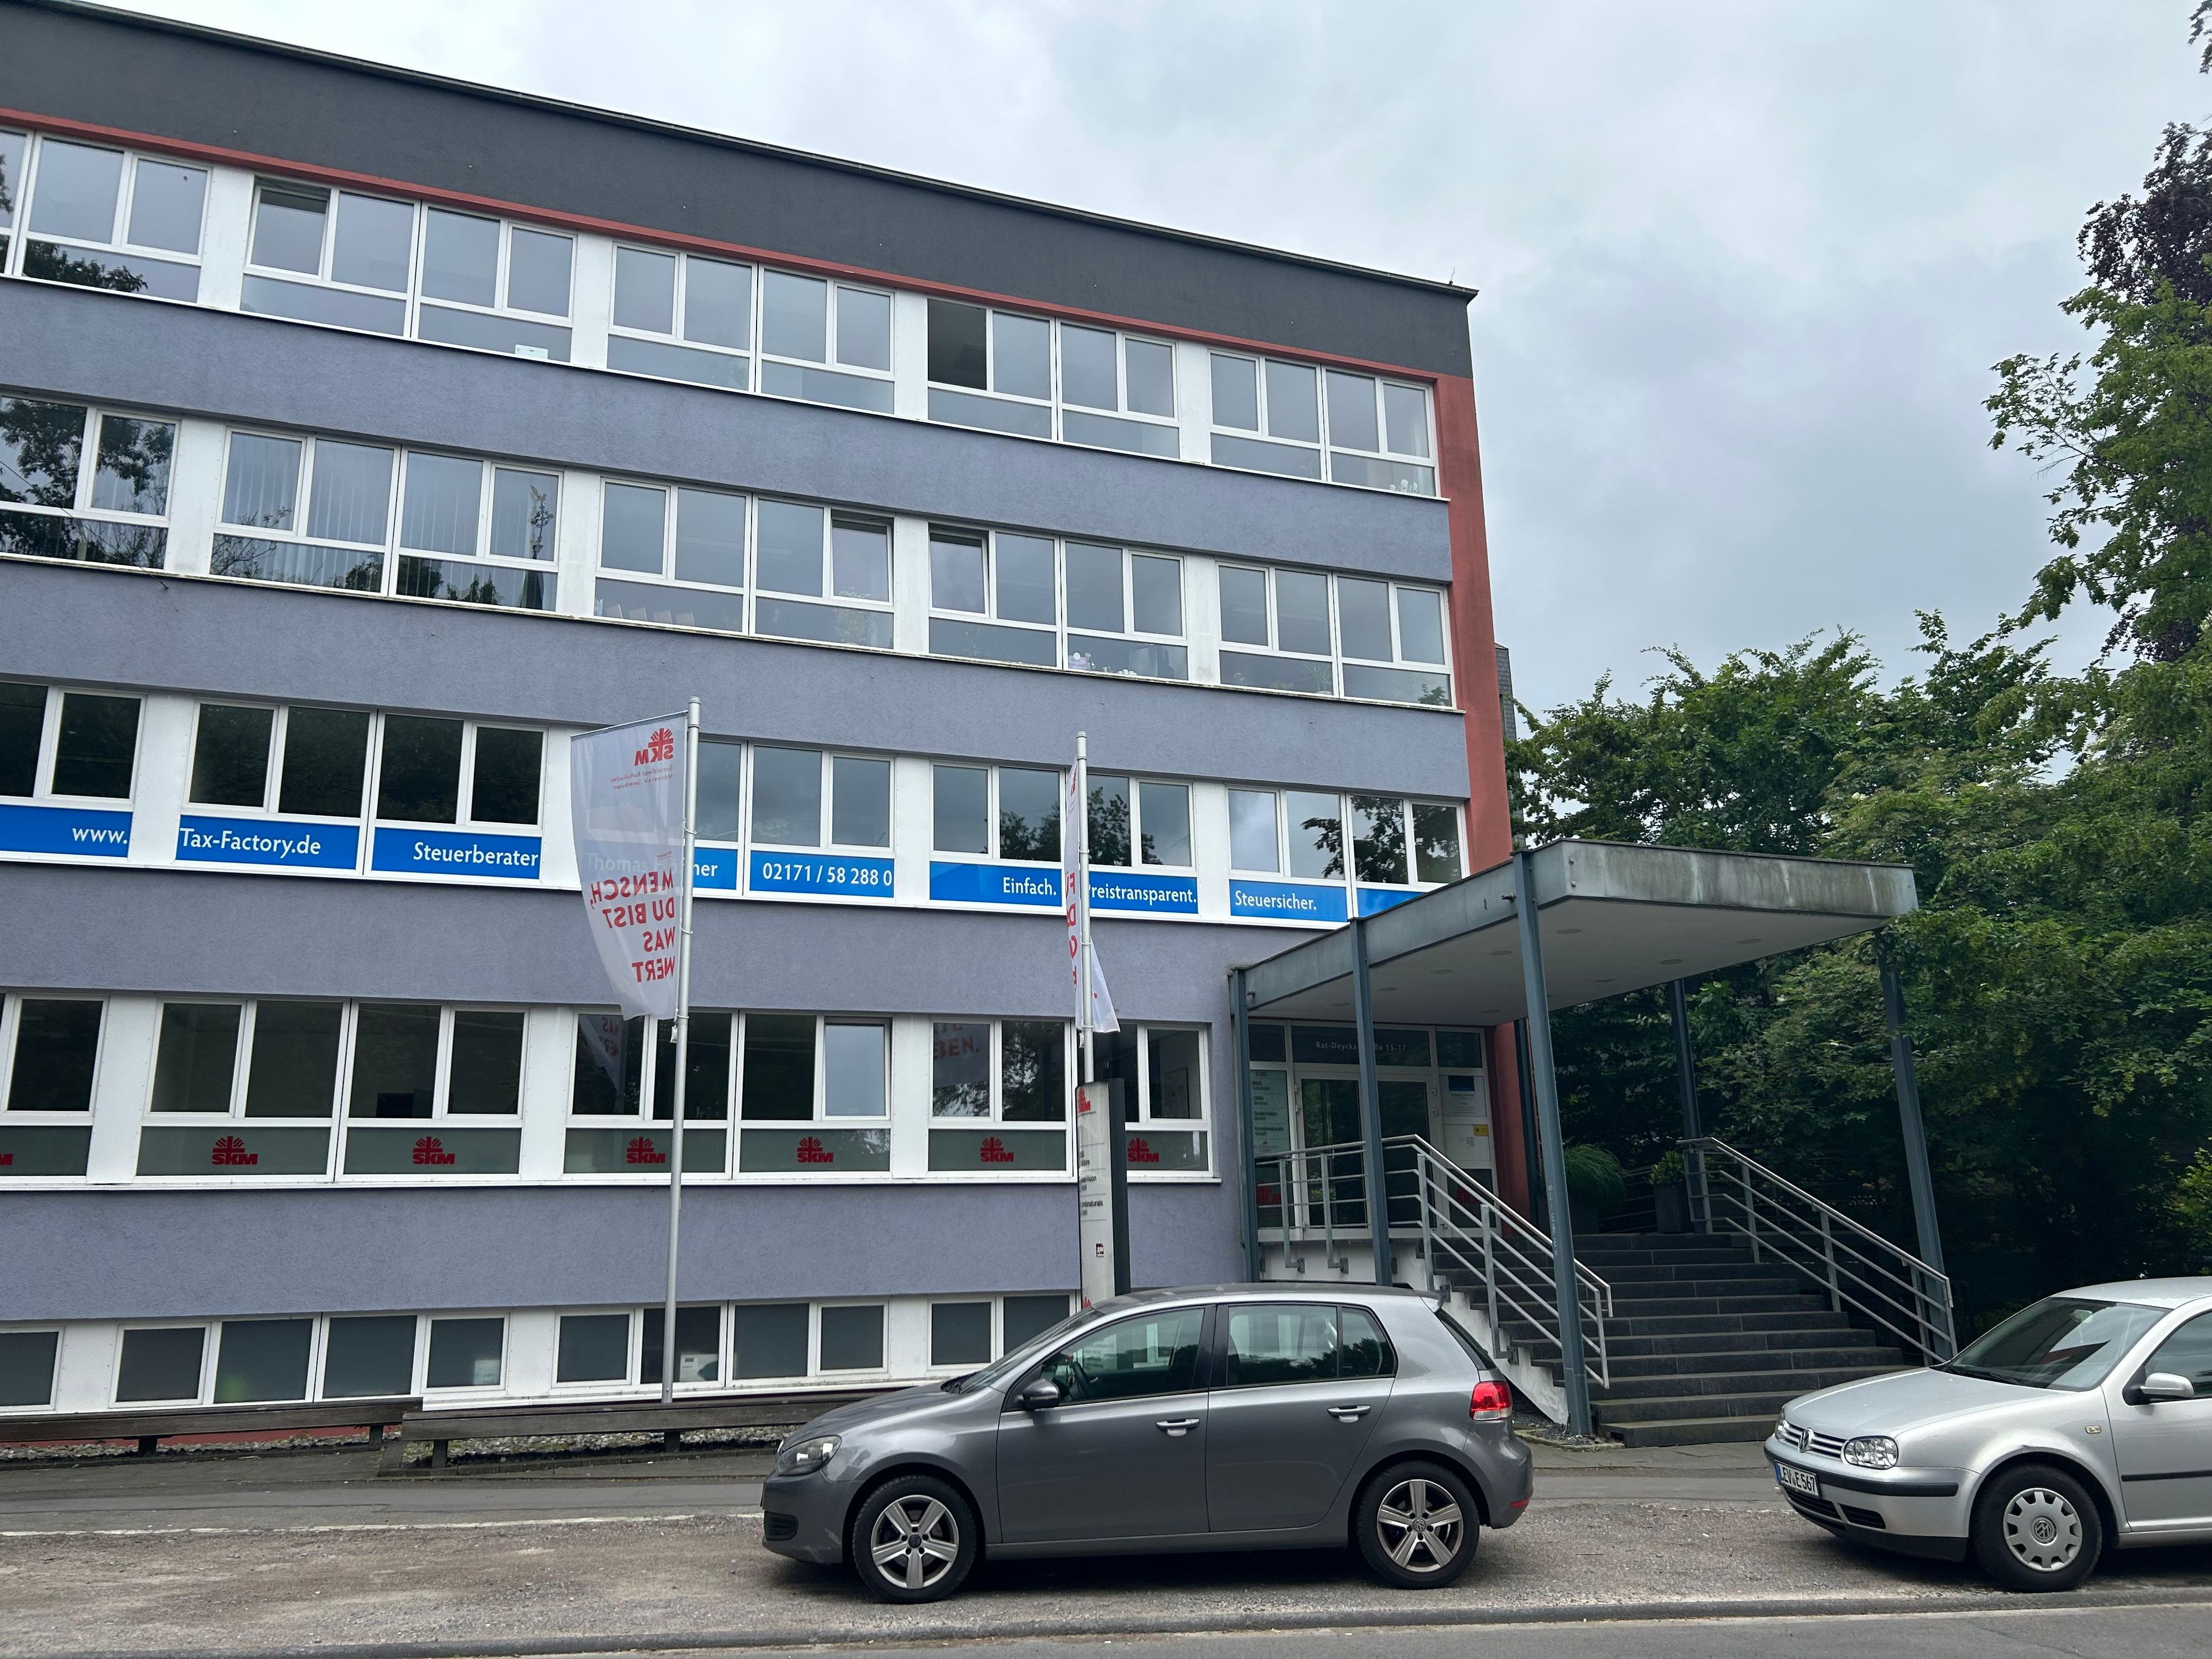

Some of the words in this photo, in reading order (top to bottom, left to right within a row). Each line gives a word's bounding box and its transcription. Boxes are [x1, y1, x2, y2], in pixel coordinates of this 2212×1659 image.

[72, 828, 127, 844] www.
[180, 827, 321, 858] Tax-Factory.de
[413, 842, 539, 867] Steuerberater
[763, 863, 810, 881] 02171
[827, 867, 846, 883] 58
[851, 868, 879, 885] 288
[883, 870, 893, 886] 0
[1003, 877, 1057, 895] Einfach.
[1089, 883, 1197, 906] reistransparent.
[1235, 890, 1317, 910] Steuersicher.
[212, 1154, 258, 1165] SKM
[413, 1154, 455, 1164] SKM
[627, 1154, 666, 1164] SKM
[797, 1154, 833, 1163] SKM
[980, 1154, 1014, 1162] SKM
[1128, 1154, 1159, 1162] SKM
